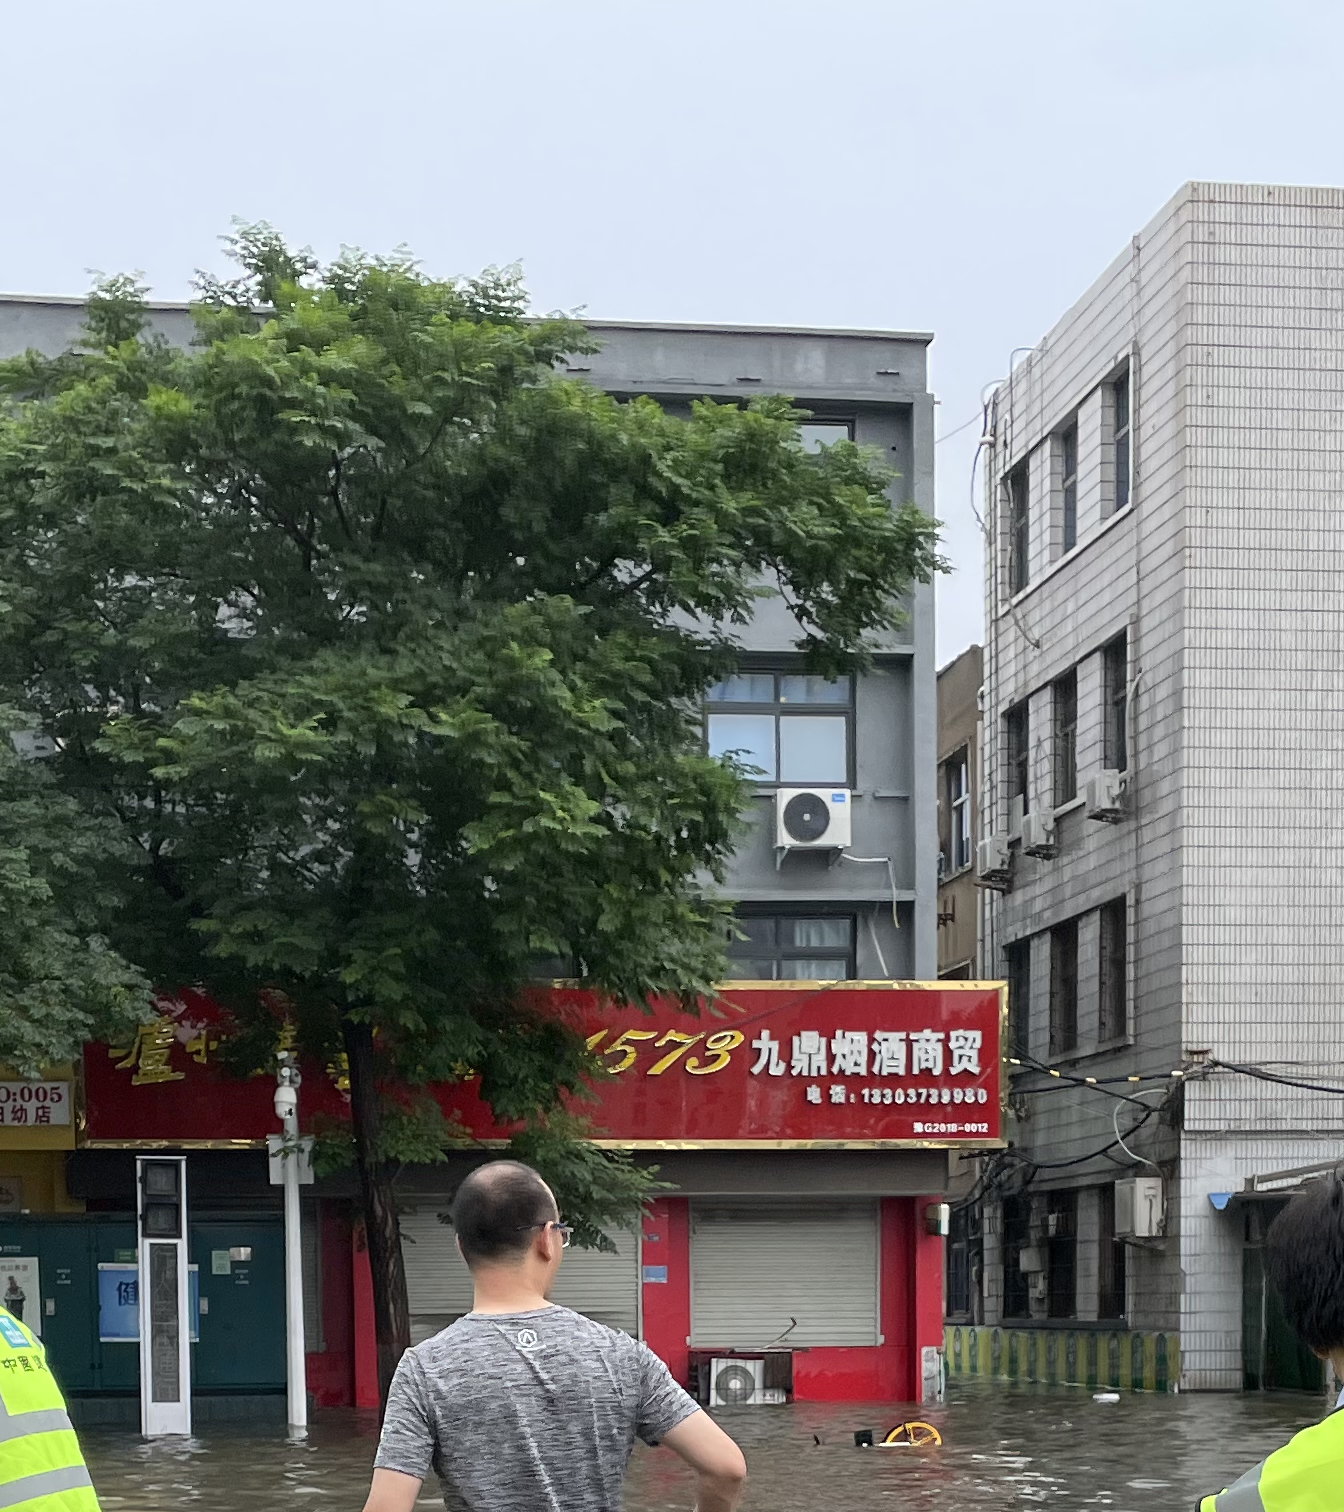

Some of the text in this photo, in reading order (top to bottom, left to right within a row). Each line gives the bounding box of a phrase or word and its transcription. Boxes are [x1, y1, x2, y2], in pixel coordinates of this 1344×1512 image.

[749, 1028, 984, 1078] 九鼎烟酒商贸
